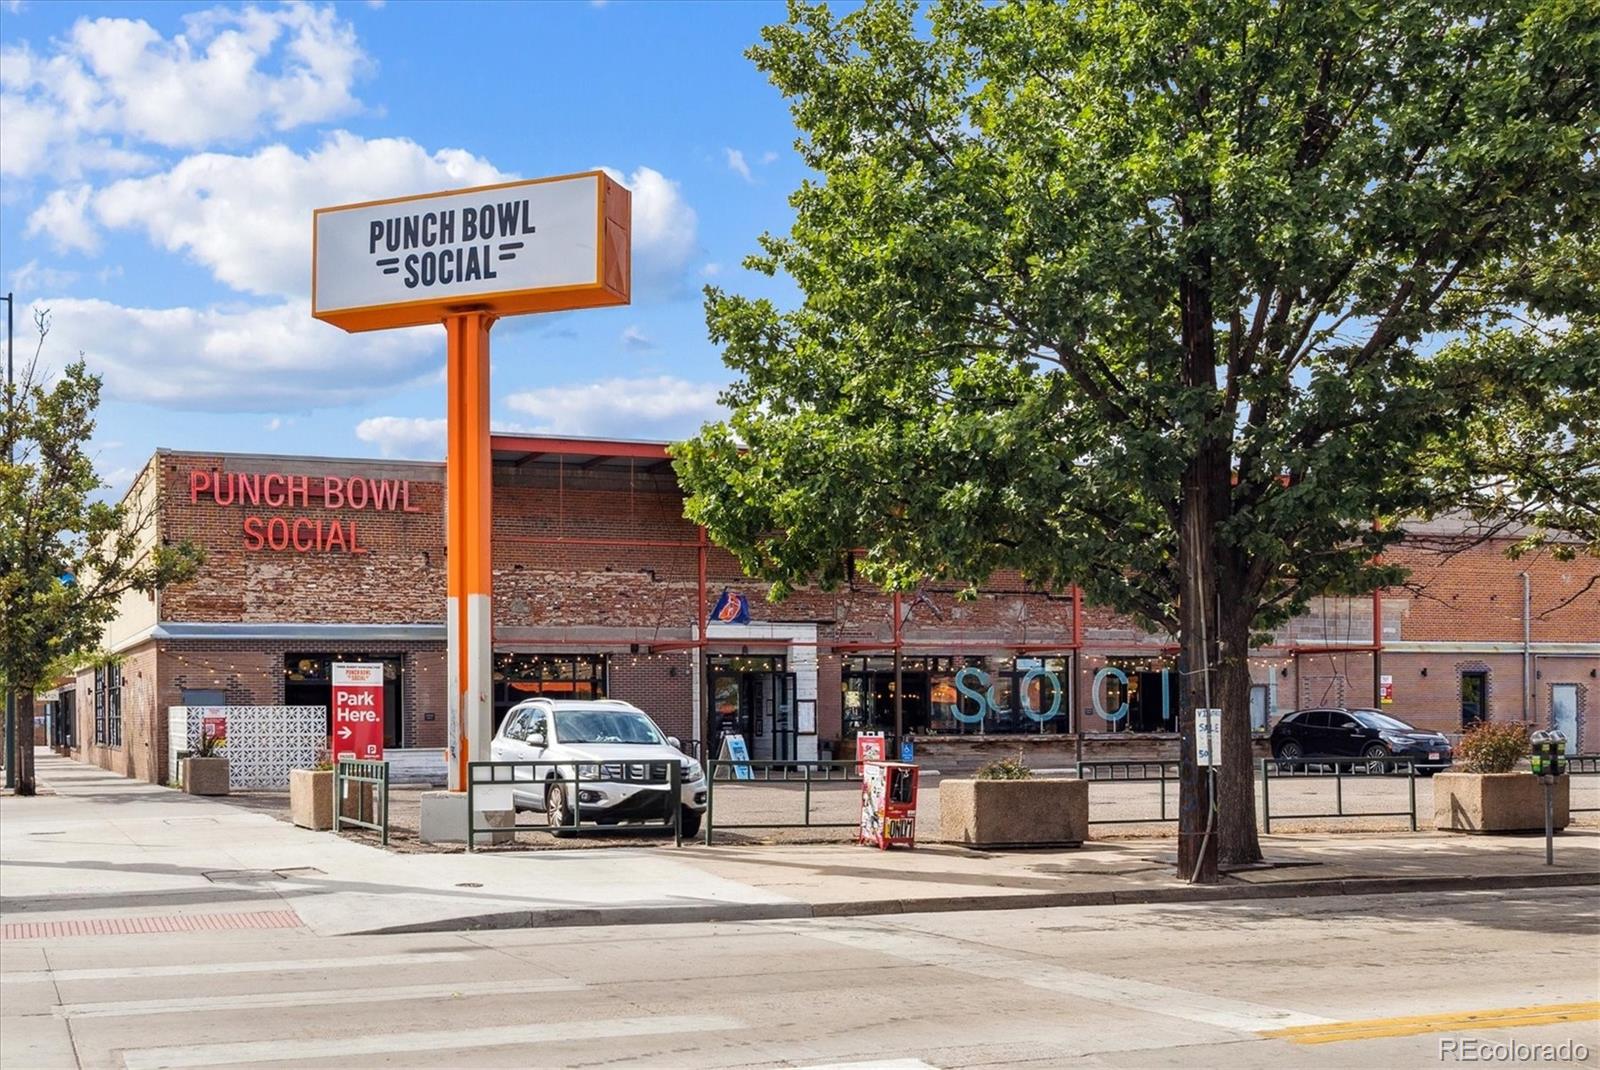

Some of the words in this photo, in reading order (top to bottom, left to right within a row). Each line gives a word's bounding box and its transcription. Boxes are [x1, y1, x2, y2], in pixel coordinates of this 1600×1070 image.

[370, 210, 455, 254] PUNCH
[462, 199, 536, 242] BOWL
[404, 245, 497, 289] SOCIAL
[190, 470, 309, 508] PUNCH
[324, 475, 420, 512] BOWL
[243, 515, 368, 554] SOCIAL
[337, 692, 374, 705] Park
[337, 707, 380, 722] Here.
